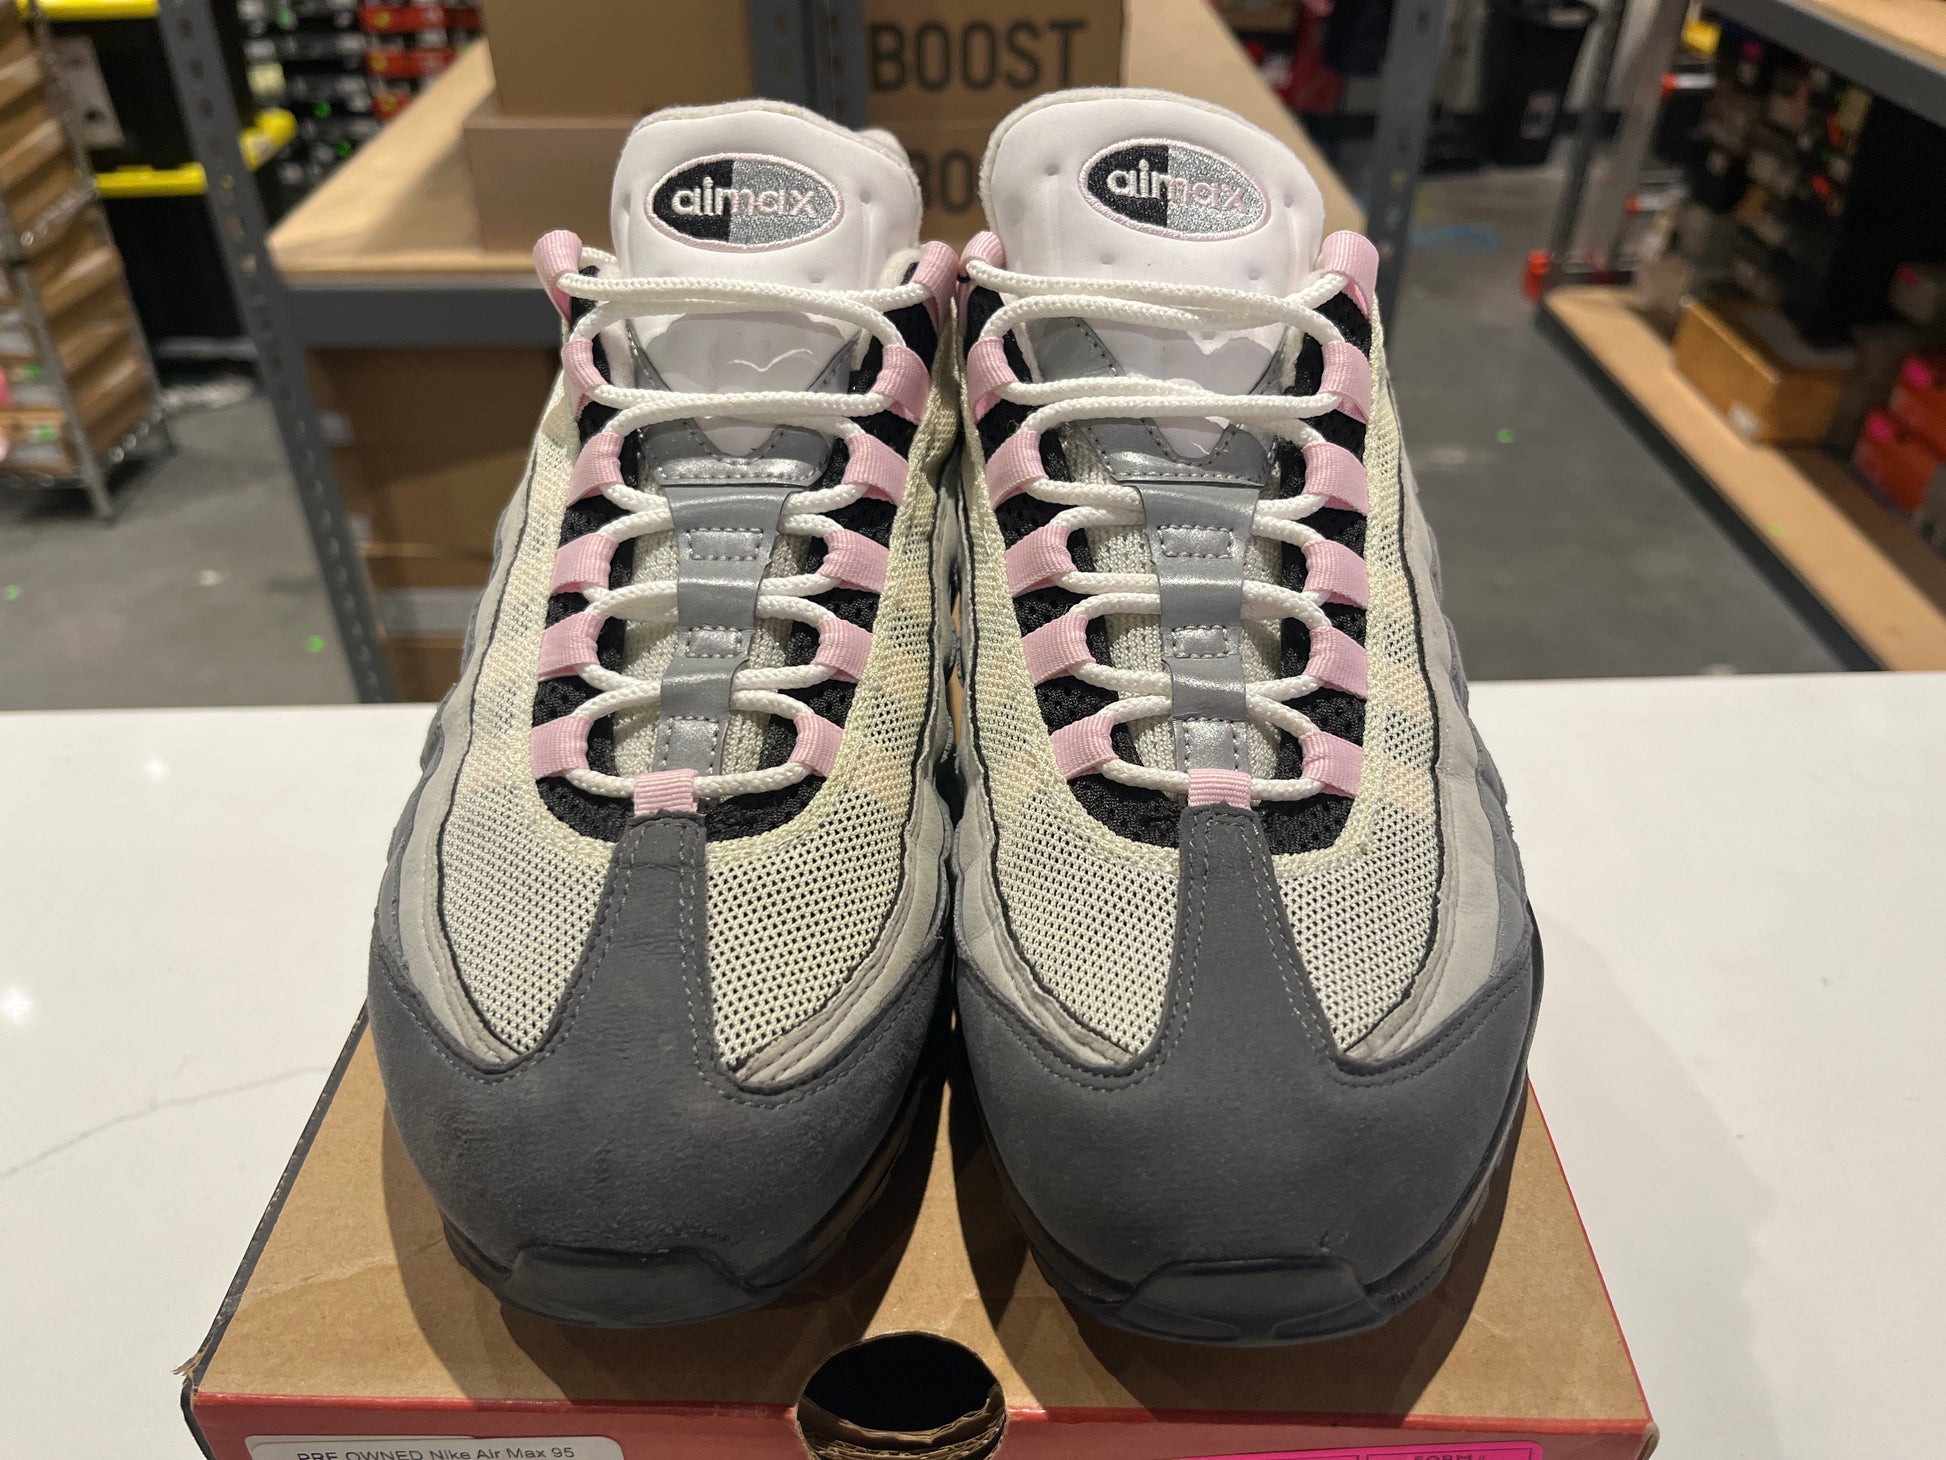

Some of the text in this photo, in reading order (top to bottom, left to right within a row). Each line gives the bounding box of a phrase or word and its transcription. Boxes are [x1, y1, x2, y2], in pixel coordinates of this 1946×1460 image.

[868, 20, 1087, 90] BOOST
[345, 1450, 423, 1460] OWNED
[429, 1449, 471, 1460] Nike
[476, 1448, 500, 1460] Air
[506, 1447, 546, 1459] Max
[551, 1447, 575, 1458] 95
